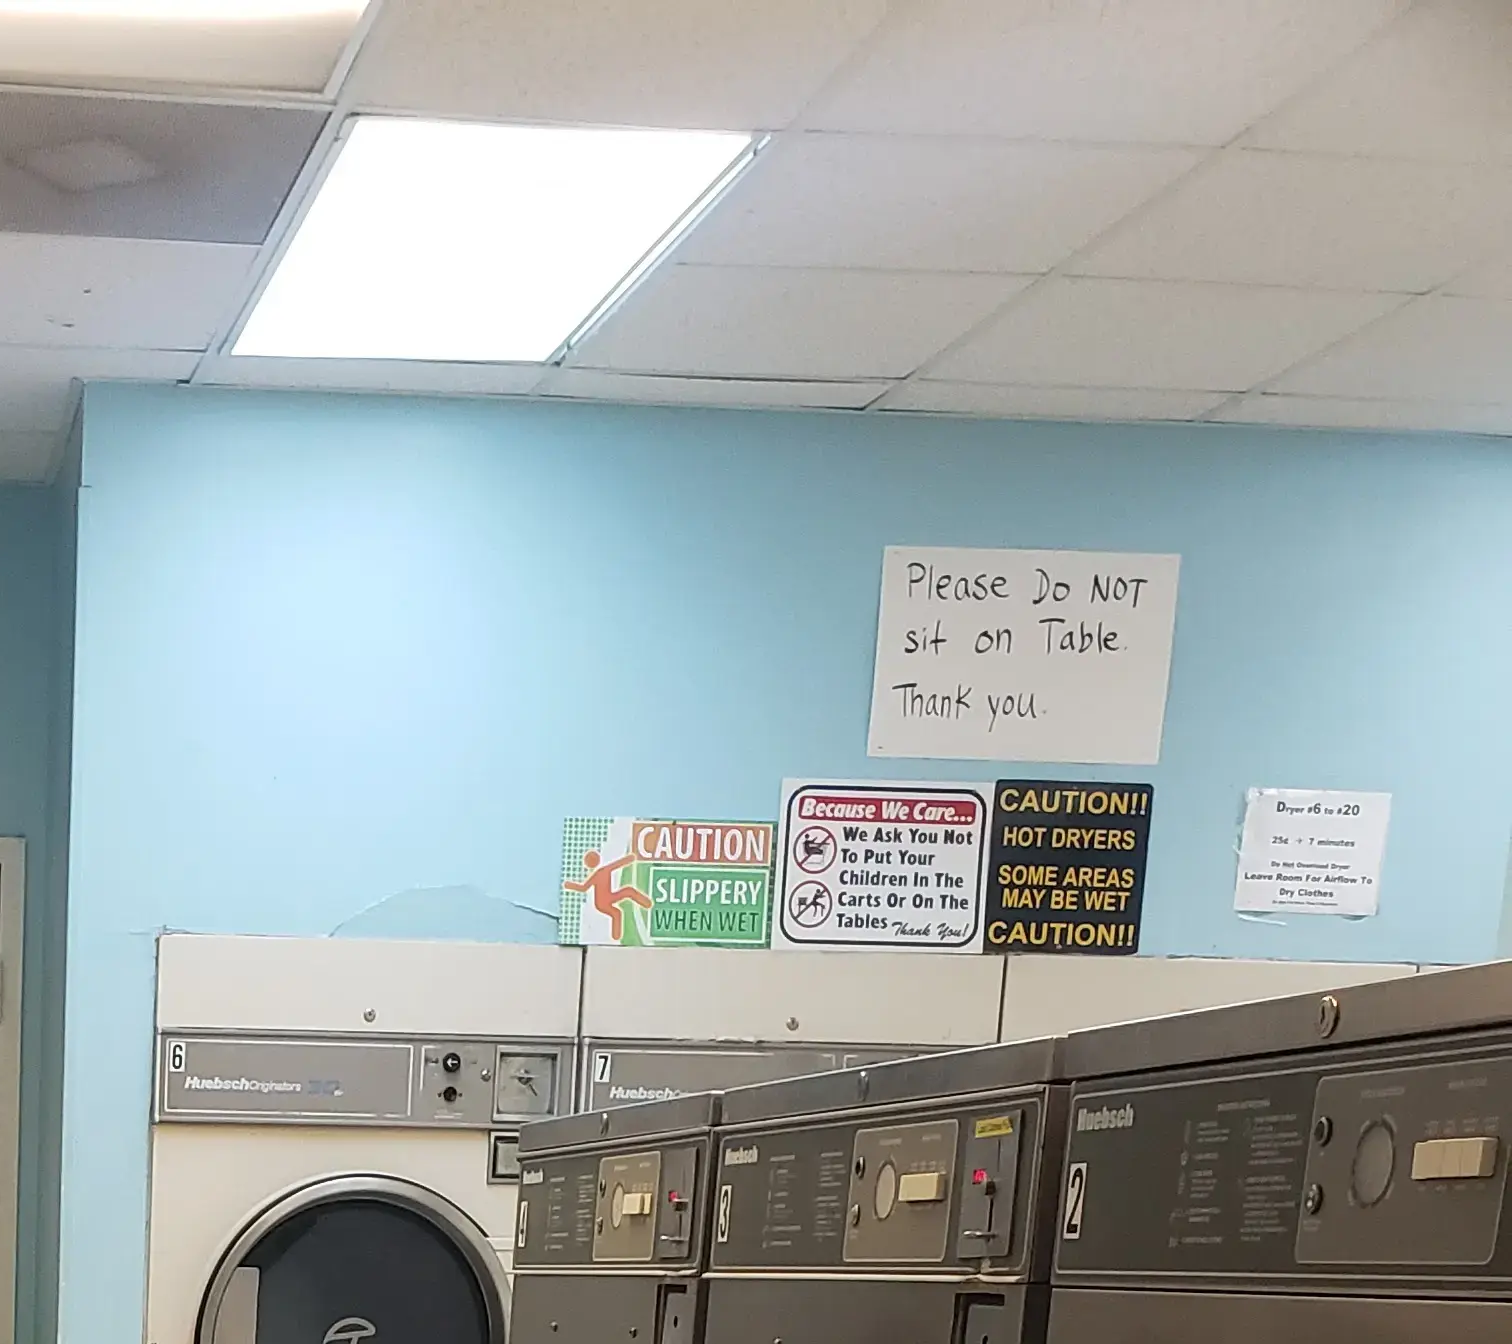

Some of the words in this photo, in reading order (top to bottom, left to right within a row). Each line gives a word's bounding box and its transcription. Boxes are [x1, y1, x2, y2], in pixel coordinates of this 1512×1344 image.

[907, 562, 1010, 601] Please
[1032, 568, 1070, 605] Do
[1090, 573, 1148, 608] NOT
[904, 620, 947, 655] sit
[975, 628, 1012, 654] on
[892, 682, 972, 720] Thank
[801, 798, 876, 819] Because
[881, 800, 910, 820] We
[912, 801, 973, 822] Care...
[999, 788, 1148, 815] CAUTION!!
[1276, 801, 1305, 815] Dryer
[1307, 803, 1321, 814] #6
[1324, 806, 1334, 815] to
[1336, 804, 1360, 816] #20
[638, 826, 765, 861] CAUTION
[842, 826, 868, 842] We
[873, 827, 903, 844] Ask
[909, 828, 938, 844] You
[943, 828, 973, 846] Not
[1002, 826, 1047, 847] HOT
[1051, 827, 1136, 850] DRYERS
[1308, 837, 1315, 846] 7
[1317, 839, 1355, 847] minutes
[840, 848, 858, 864] To
[864, 849, 892, 865] Put
[898, 850, 935, 866] Your
[839, 870, 908, 887] Children
[913, 872, 929, 887] In
[935, 872, 964, 888] The
[998, 864, 1059, 886] SOME
[1062, 866, 1135, 888] AREAS
[1244, 872, 1273, 881] Leave
[1275, 873, 1303, 882] Room
[1305, 874, 1321, 883] For
[1323, 875, 1358, 884] Airflow
[1360, 876, 1373, 885] To
[655, 878, 762, 906] SLIPPERY
[837, 891, 881, 908] Carts
[887, 893, 906, 908] Or
[912, 893, 934, 909] On
[939, 894, 969, 910] The
[1001, 888, 1047, 909] MAY
[1050, 889, 1079, 910] BE
[1084, 891, 1131, 911] WET
[1279, 888, 1294, 898] Dry
[1298, 888, 1334, 898] Clothes
[655, 909, 713, 932] WHEN
[719, 911, 759, 933] WET
[836, 913, 888, 929] Tables
[891, 922, 932, 936] Thank
[937, 923, 969, 940] You!
[988, 920, 1135, 947] CAUTION!!
[171, 1044, 183, 1070] 6
[598, 1055, 608, 1080] 7
[184, 1075, 250, 1091] Huebsch
[609, 1086, 673, 1100] Huebsch
[1066, 1167, 1083, 1234] 2
[719, 1188, 729, 1239] 3
